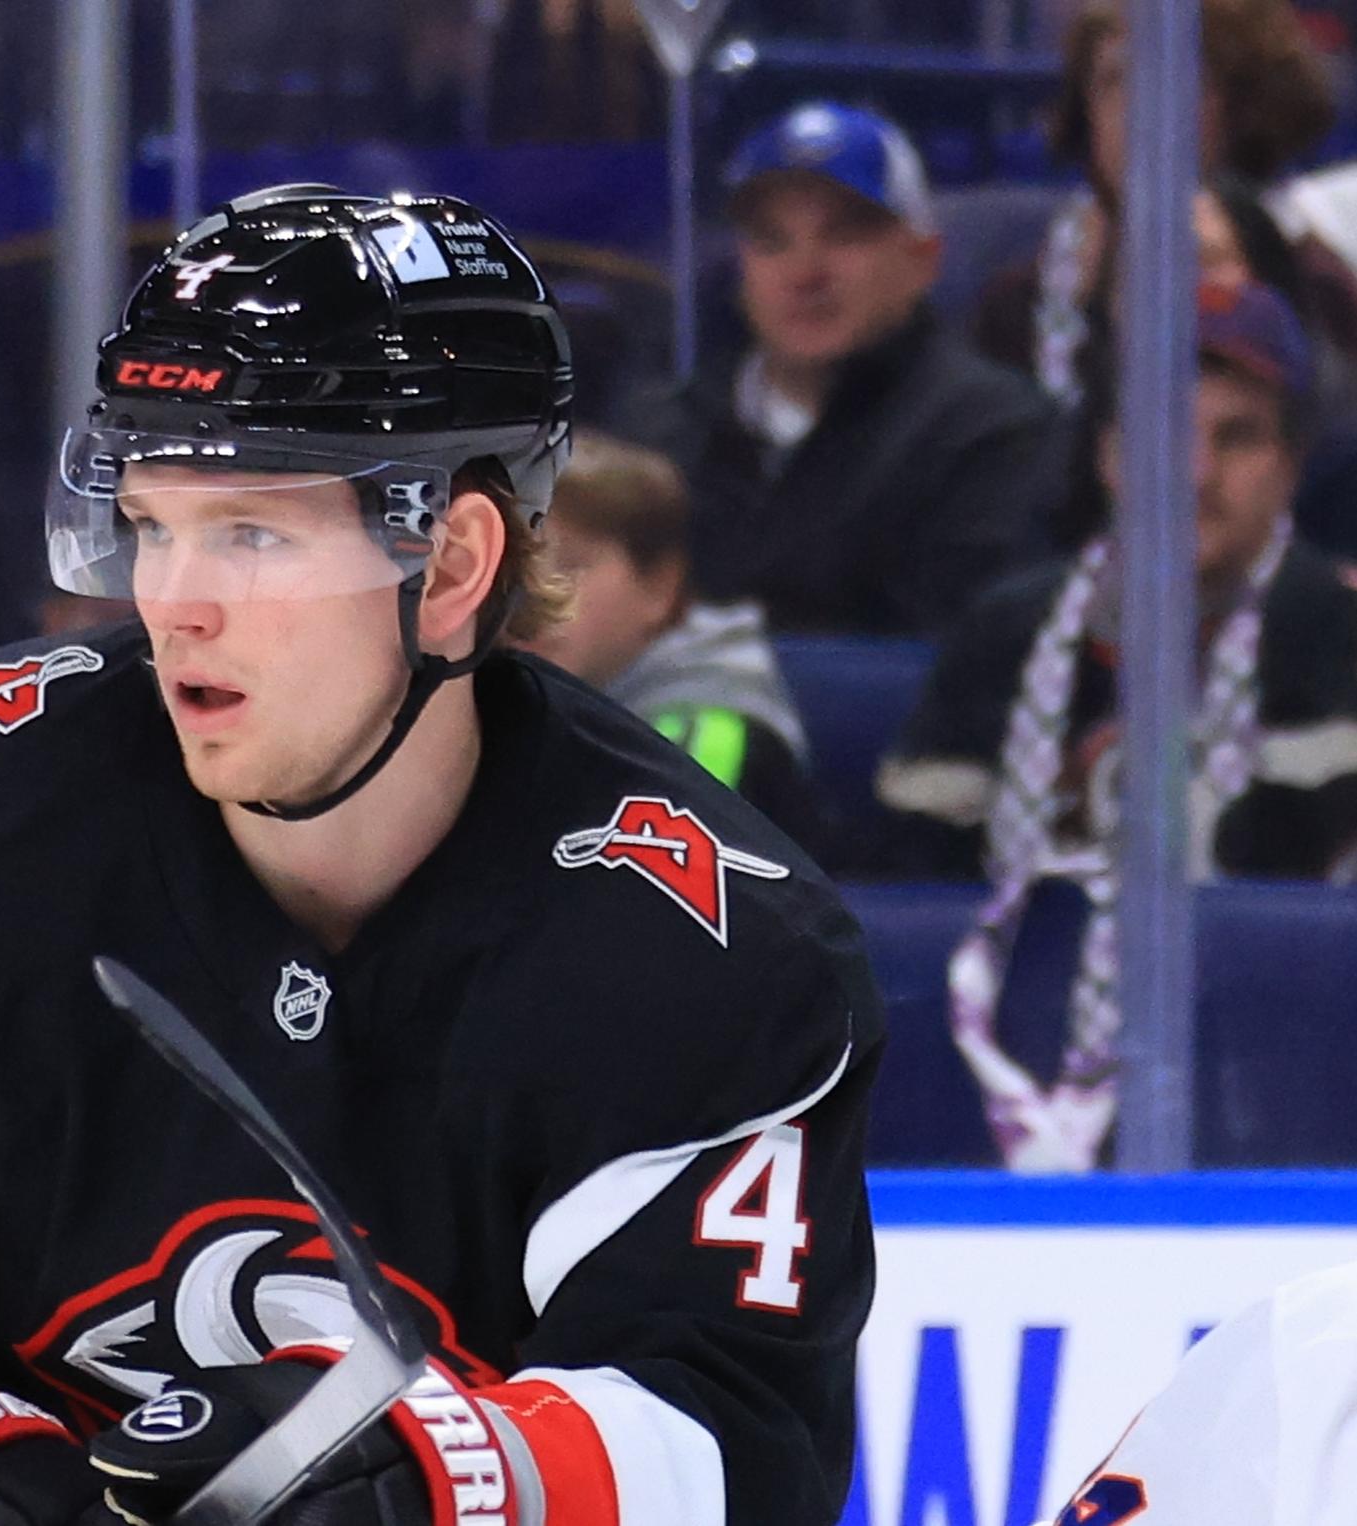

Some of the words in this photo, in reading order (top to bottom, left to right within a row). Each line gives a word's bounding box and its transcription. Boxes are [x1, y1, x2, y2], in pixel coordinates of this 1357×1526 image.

[432, 221, 489, 238] Trusted
[445, 239, 486, 255] Nurse
[173, 252, 237, 301] 4
[454, 258, 509, 279] Staffing
[117, 361, 224, 392] CCM
[284, 991, 321, 1017] NHL
[692, 1120, 813, 1316] 4
